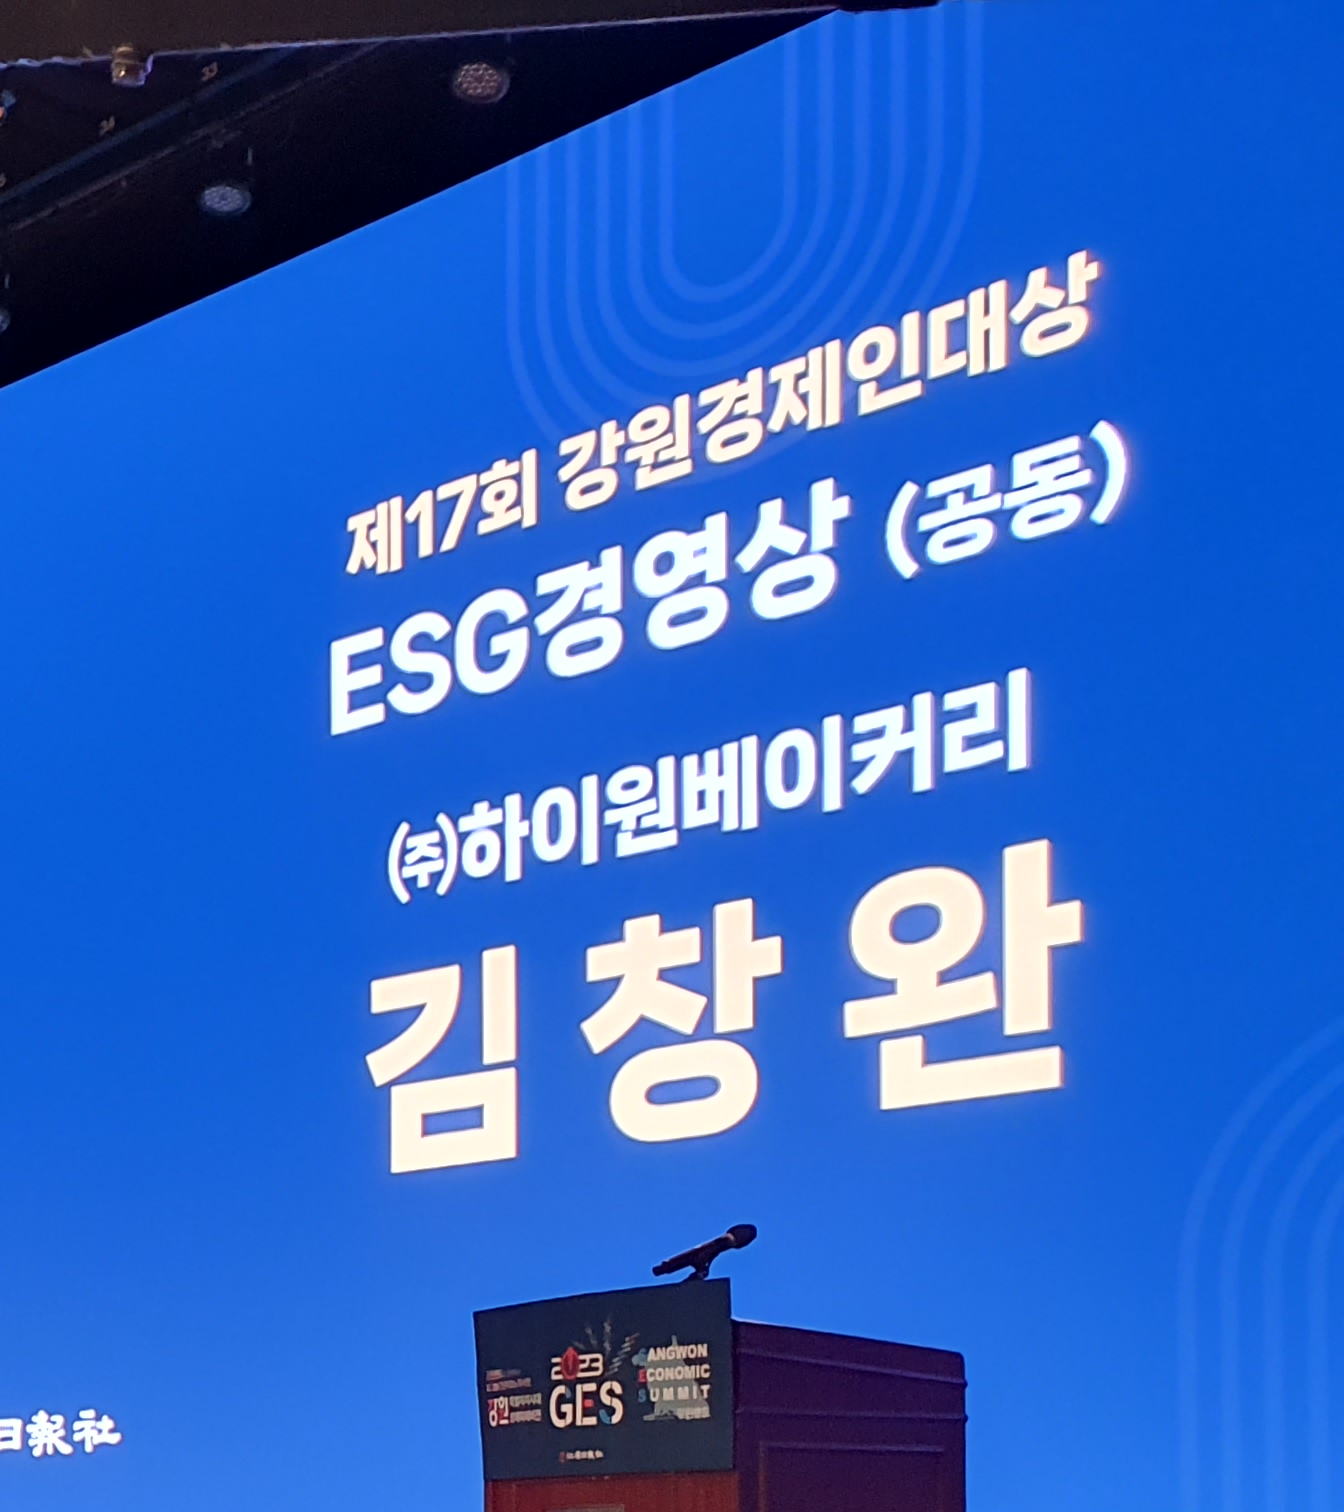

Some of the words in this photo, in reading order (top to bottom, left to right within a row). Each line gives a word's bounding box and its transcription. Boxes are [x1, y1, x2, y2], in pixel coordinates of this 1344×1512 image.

[346, 449, 537, 574] 제17회
[558, 250, 1100, 510] 강원경제인대상
[330, 478, 852, 735] ESG경영상
[886, 421, 1130, 578] (공동)
[366, 944, 518, 1174] 김
[580, 897, 783, 1142] 창
[843, 839, 1084, 1110] 완
[637, 1344, 709, 1362] GANGWON
[638, 1364, 711, 1384] ECONOMIC
[549, 1380, 625, 1429] GES
[637, 1384, 711, 1403] SUMMIT
